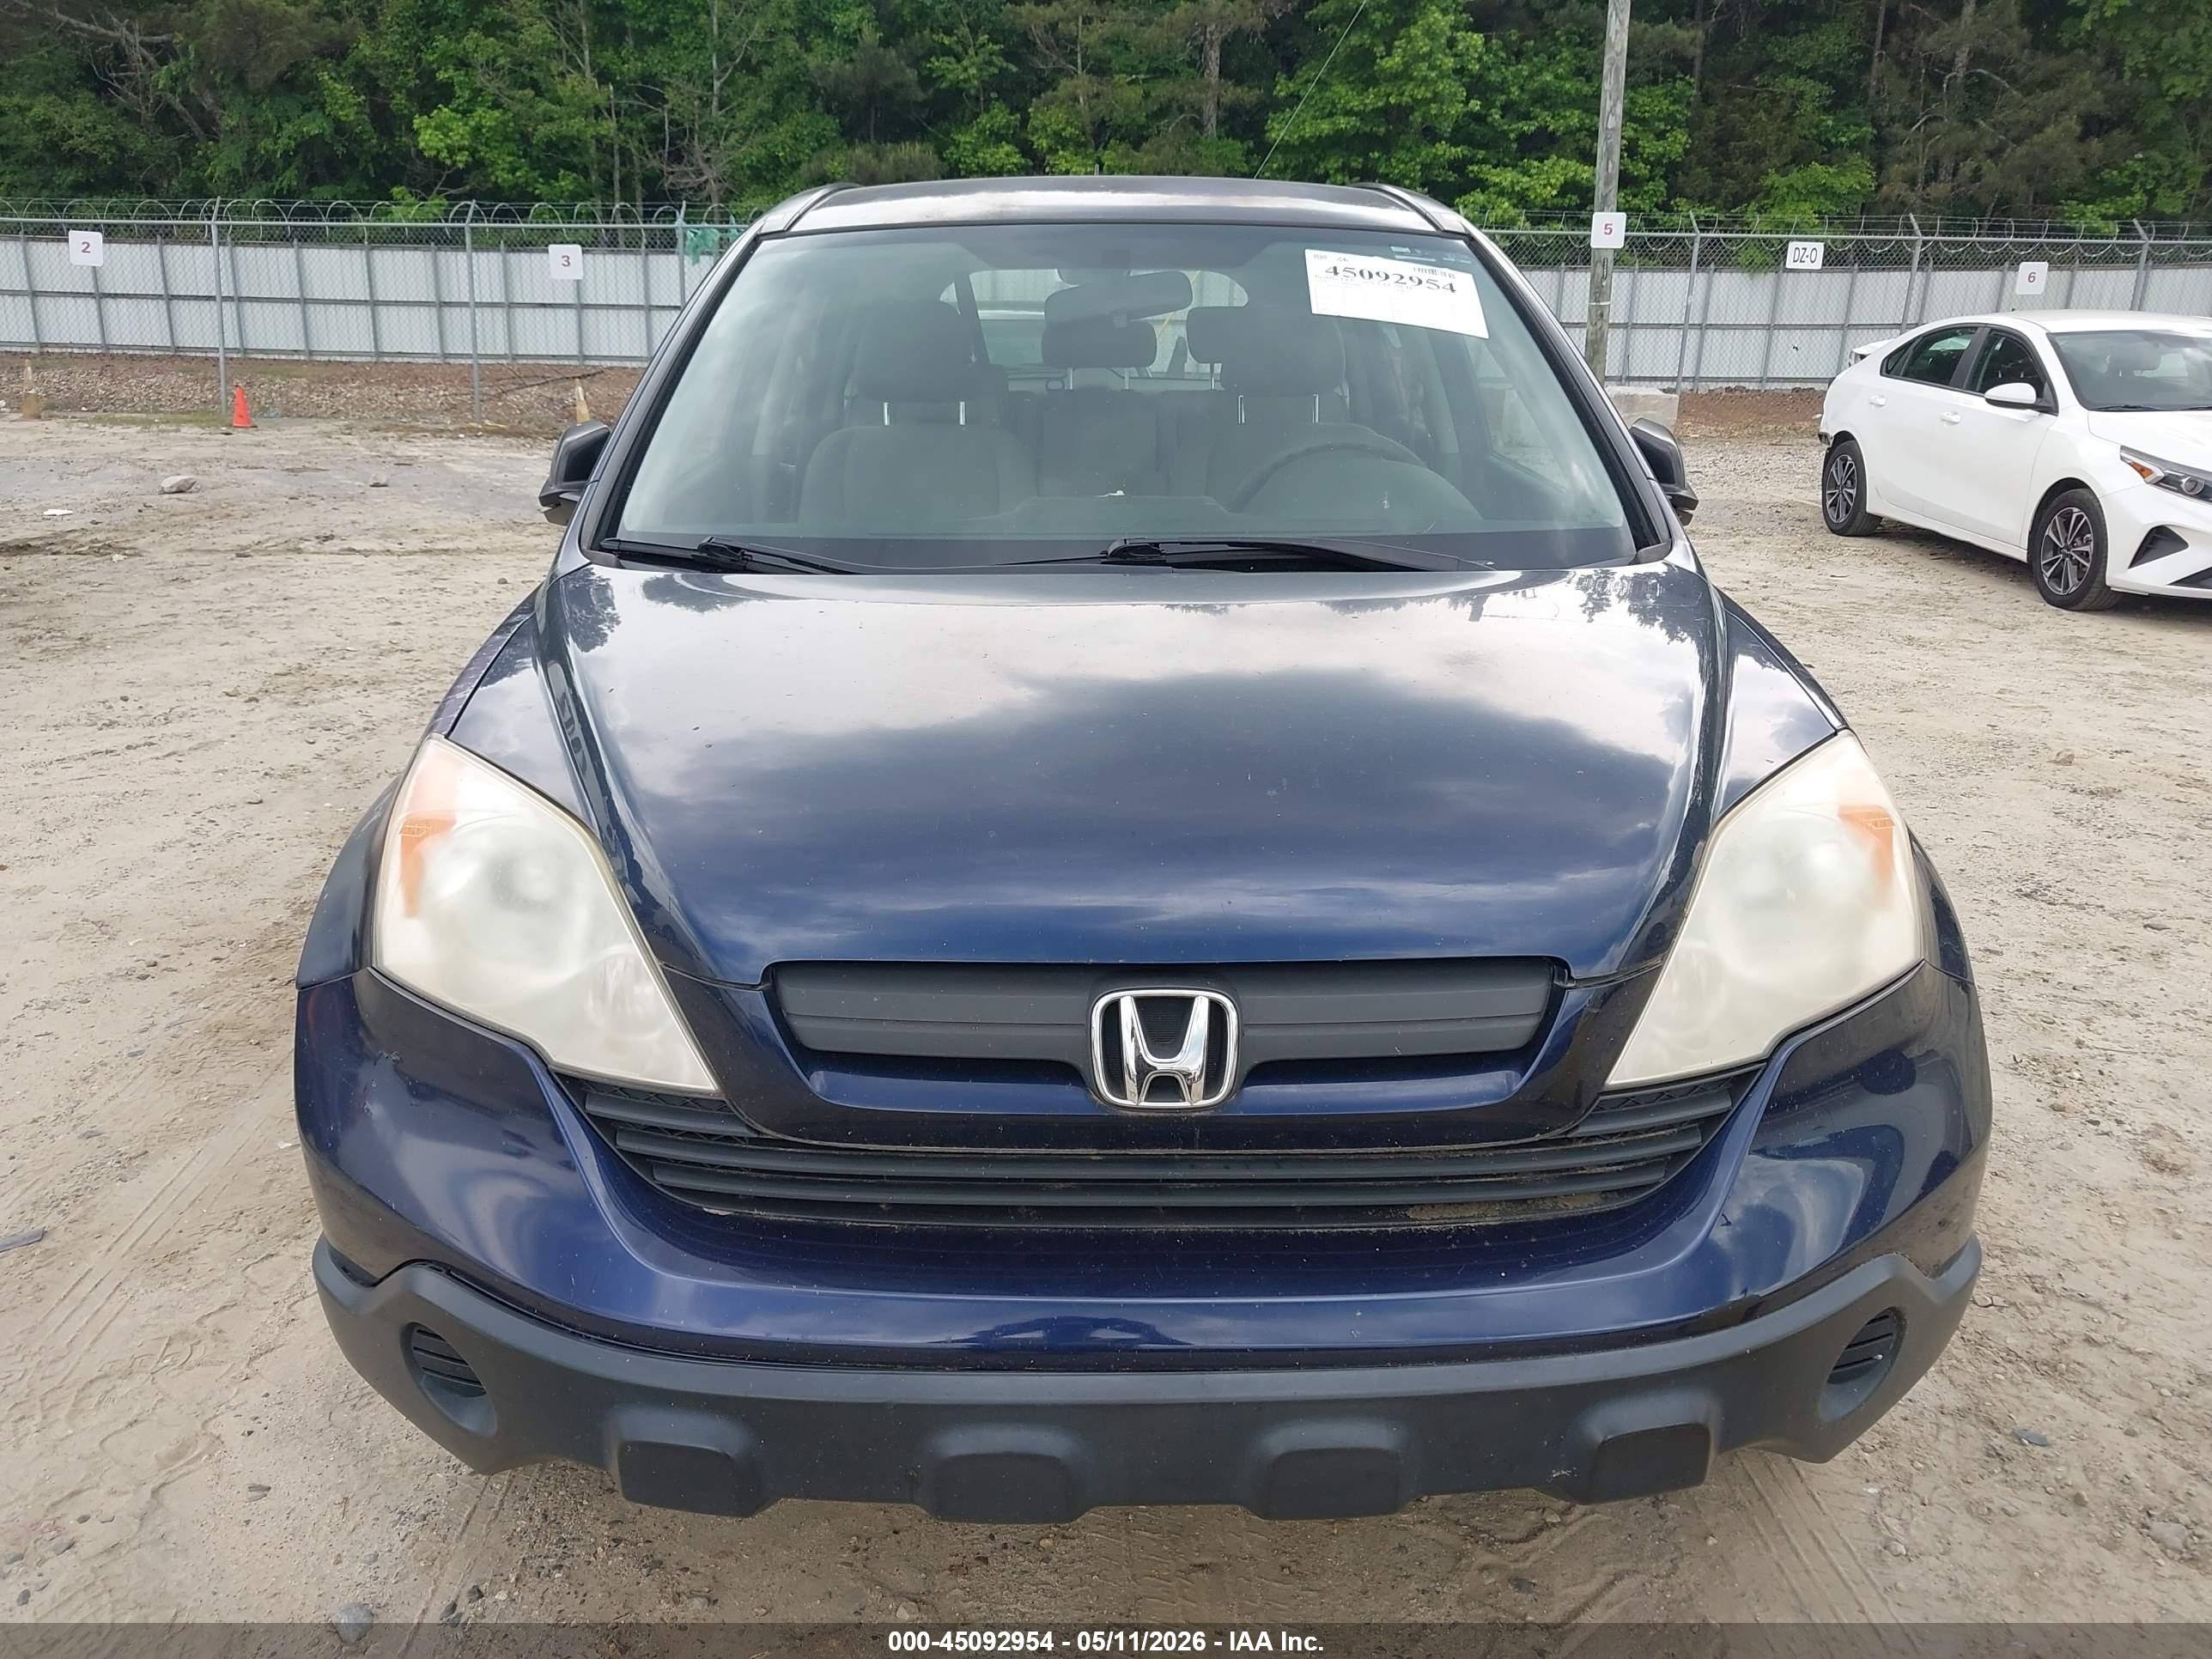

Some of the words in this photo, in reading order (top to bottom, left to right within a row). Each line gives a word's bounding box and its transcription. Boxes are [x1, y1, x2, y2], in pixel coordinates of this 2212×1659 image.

[1604, 223, 1613, 235] 5
[82, 241, 90, 253] 2
[562, 255, 571, 267] 3
[1325, 265, 1457, 294] 45092954
[2028, 271, 2037, 283] 6
